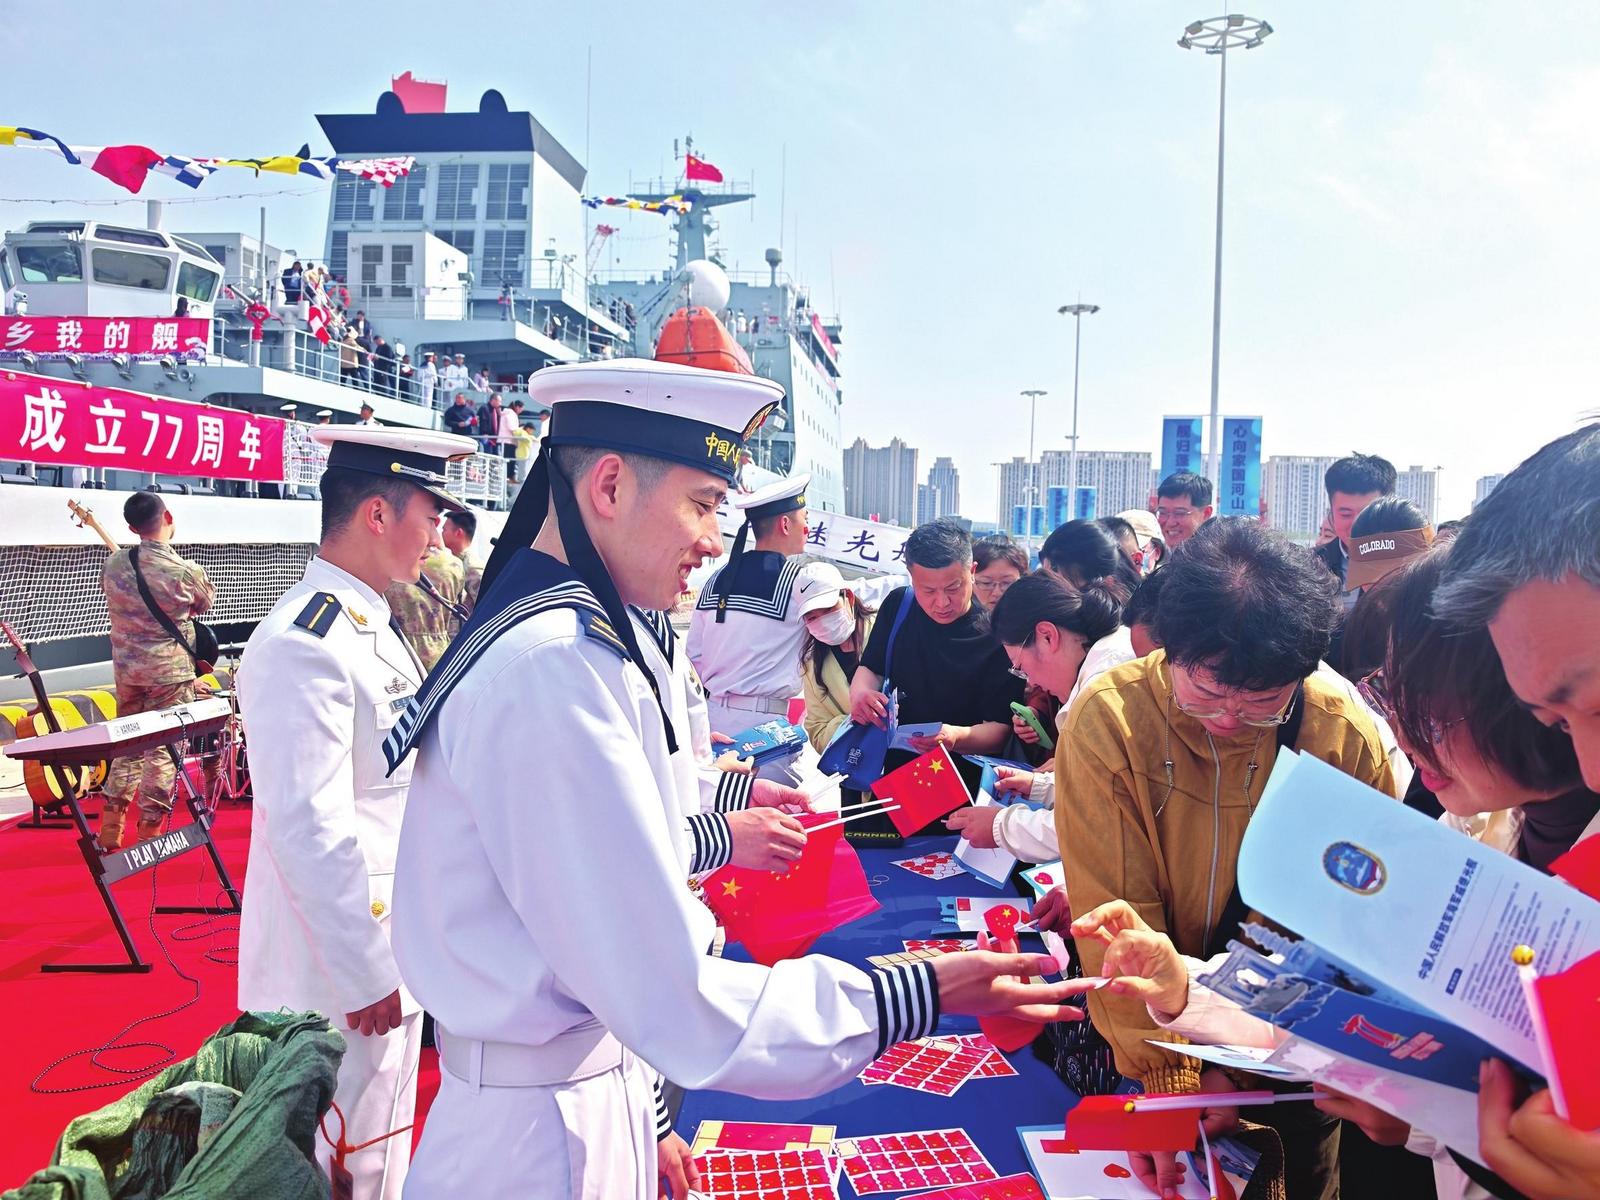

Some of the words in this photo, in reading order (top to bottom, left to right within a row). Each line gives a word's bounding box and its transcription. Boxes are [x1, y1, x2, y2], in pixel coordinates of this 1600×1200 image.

[5, 319, 178, 350] 乡我的舰
[19, 387, 261, 471] 成立77周年
[1231, 424, 1247, 510] 心向家国河山
[1358, 539, 1395, 555] COLORADO
[123, 852, 133, 870] I
[130, 843, 155, 868] PLAY
[152, 831, 190, 858] YAMAHA
